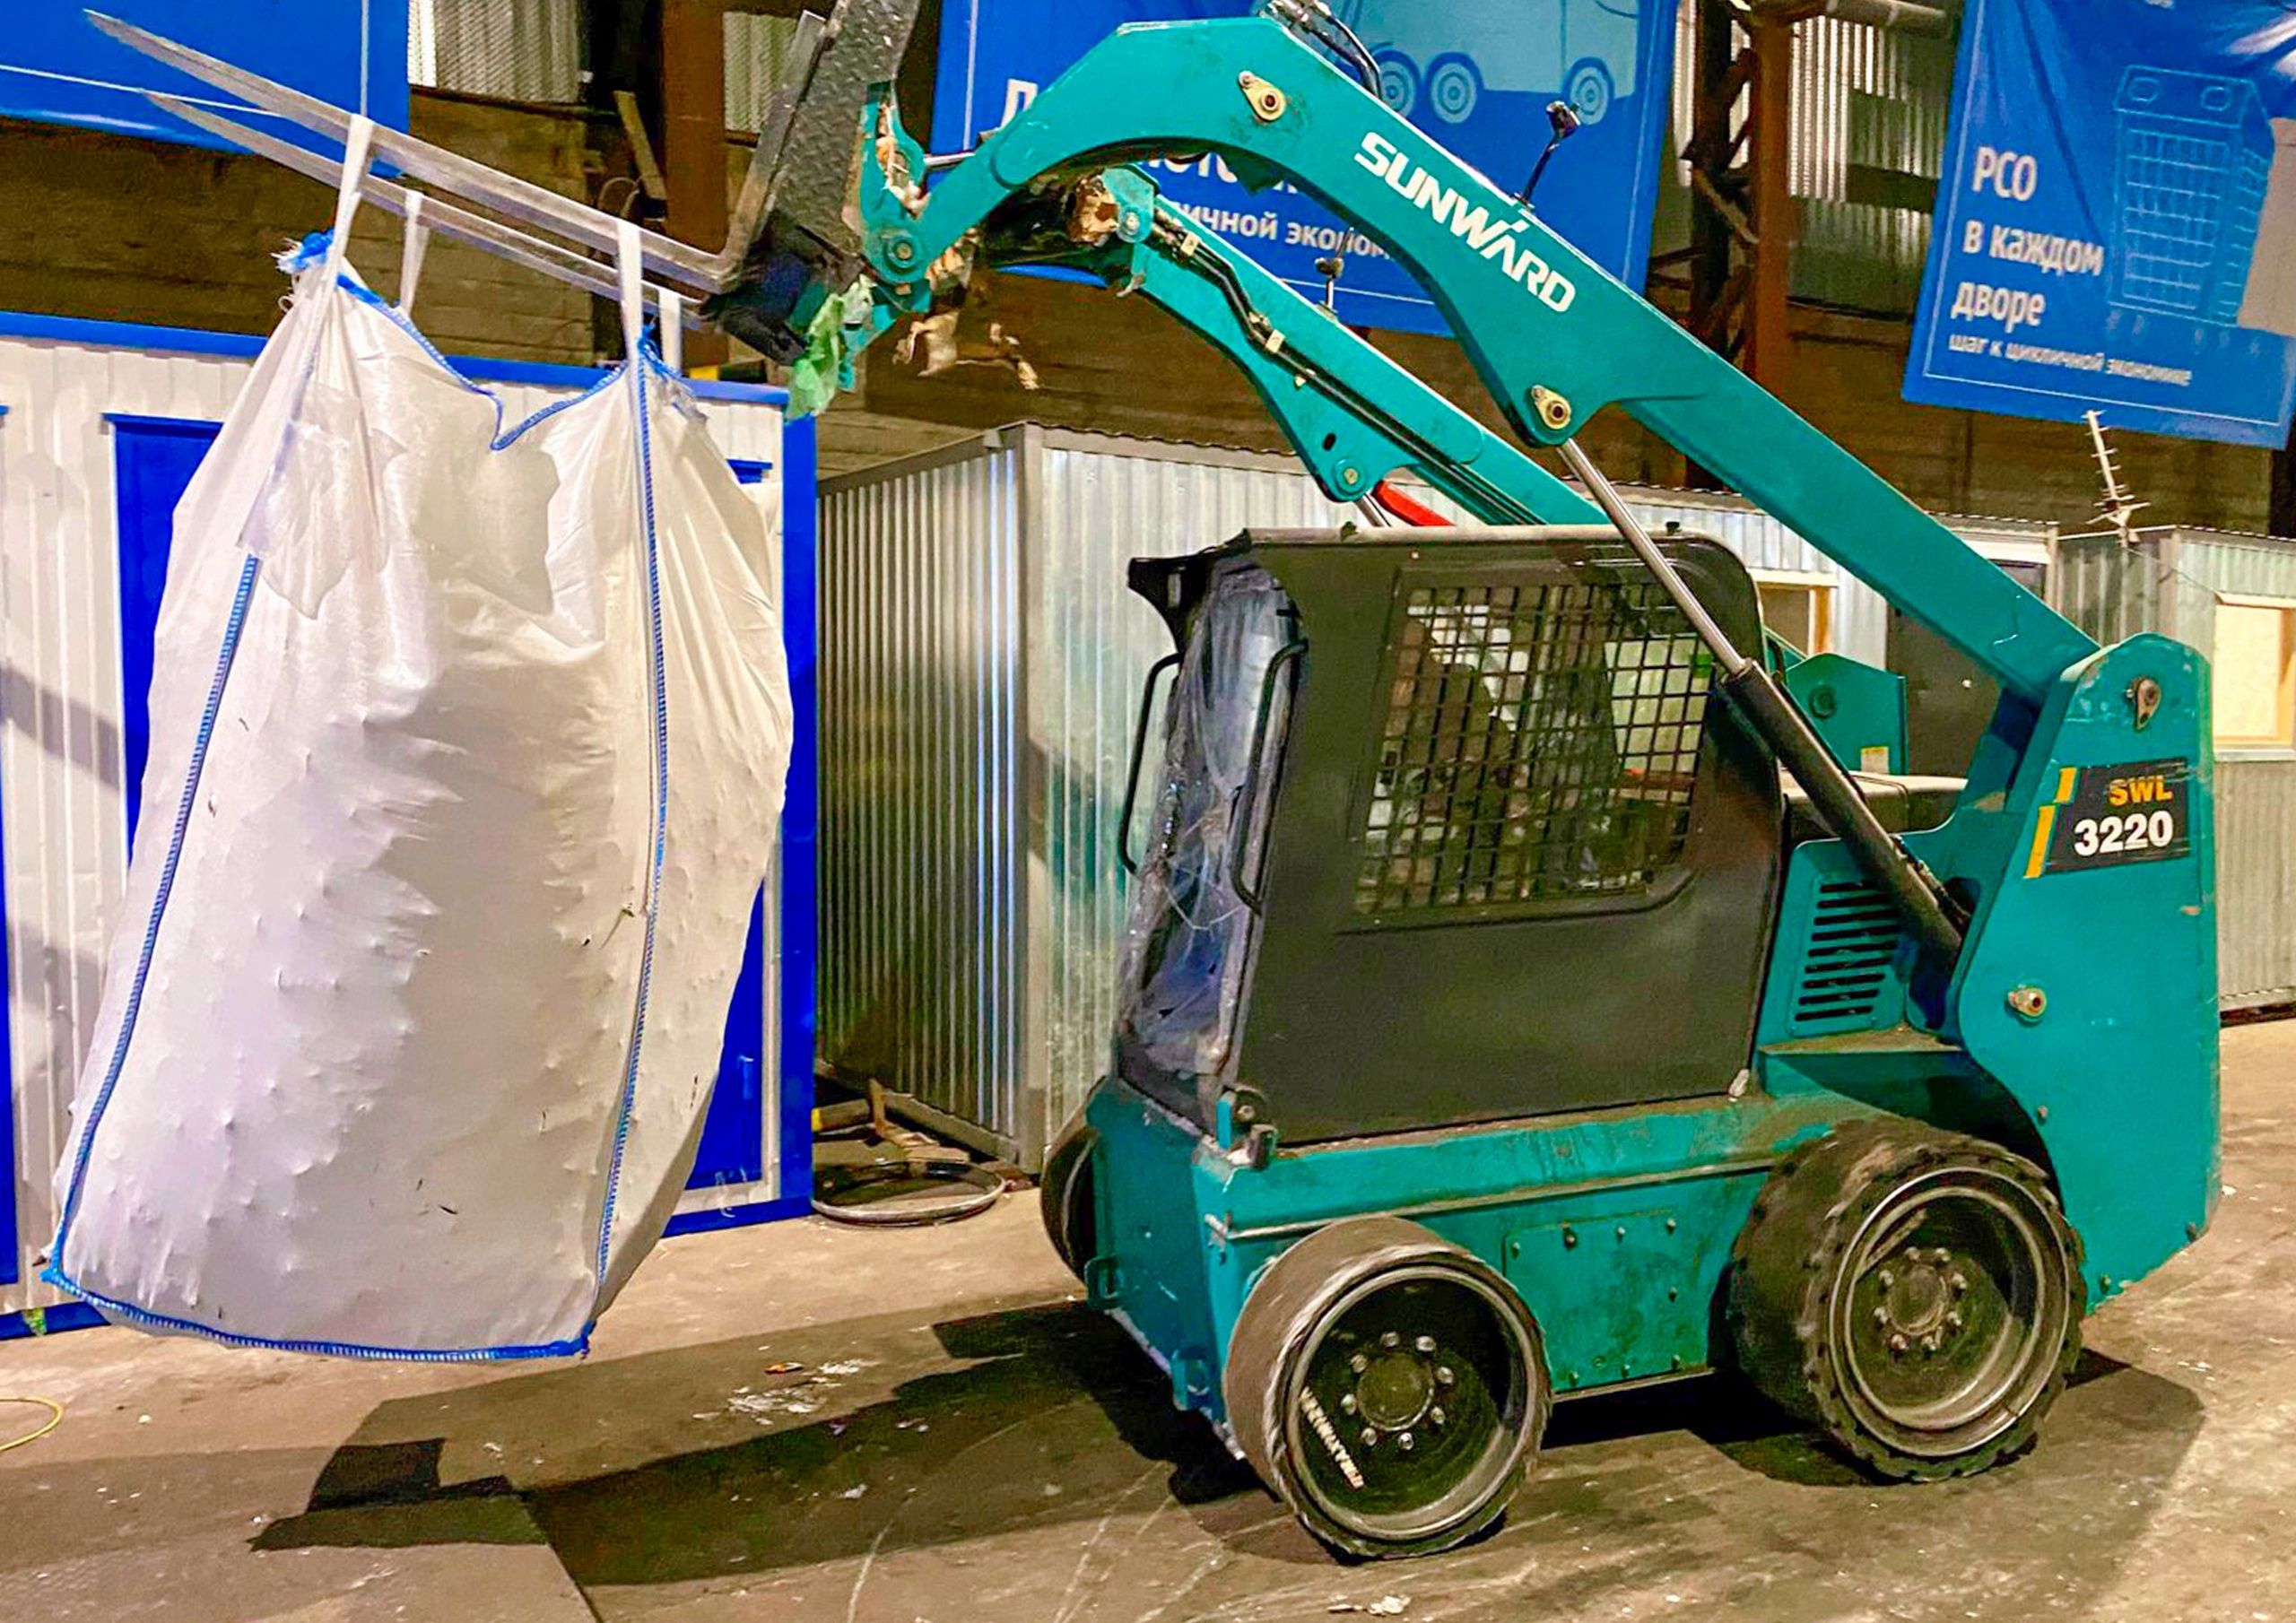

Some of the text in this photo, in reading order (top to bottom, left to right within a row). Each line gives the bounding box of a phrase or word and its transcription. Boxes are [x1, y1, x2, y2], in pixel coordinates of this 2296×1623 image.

[1972, 147, 2038, 201] РСО
[1354, 132, 1576, 312] SUNWARD
[1989, 225, 2104, 276] каждом
[1951, 282, 2045, 334] дворе
[2109, 775, 2173, 806] SWL
[2074, 811, 2174, 856] 3220
